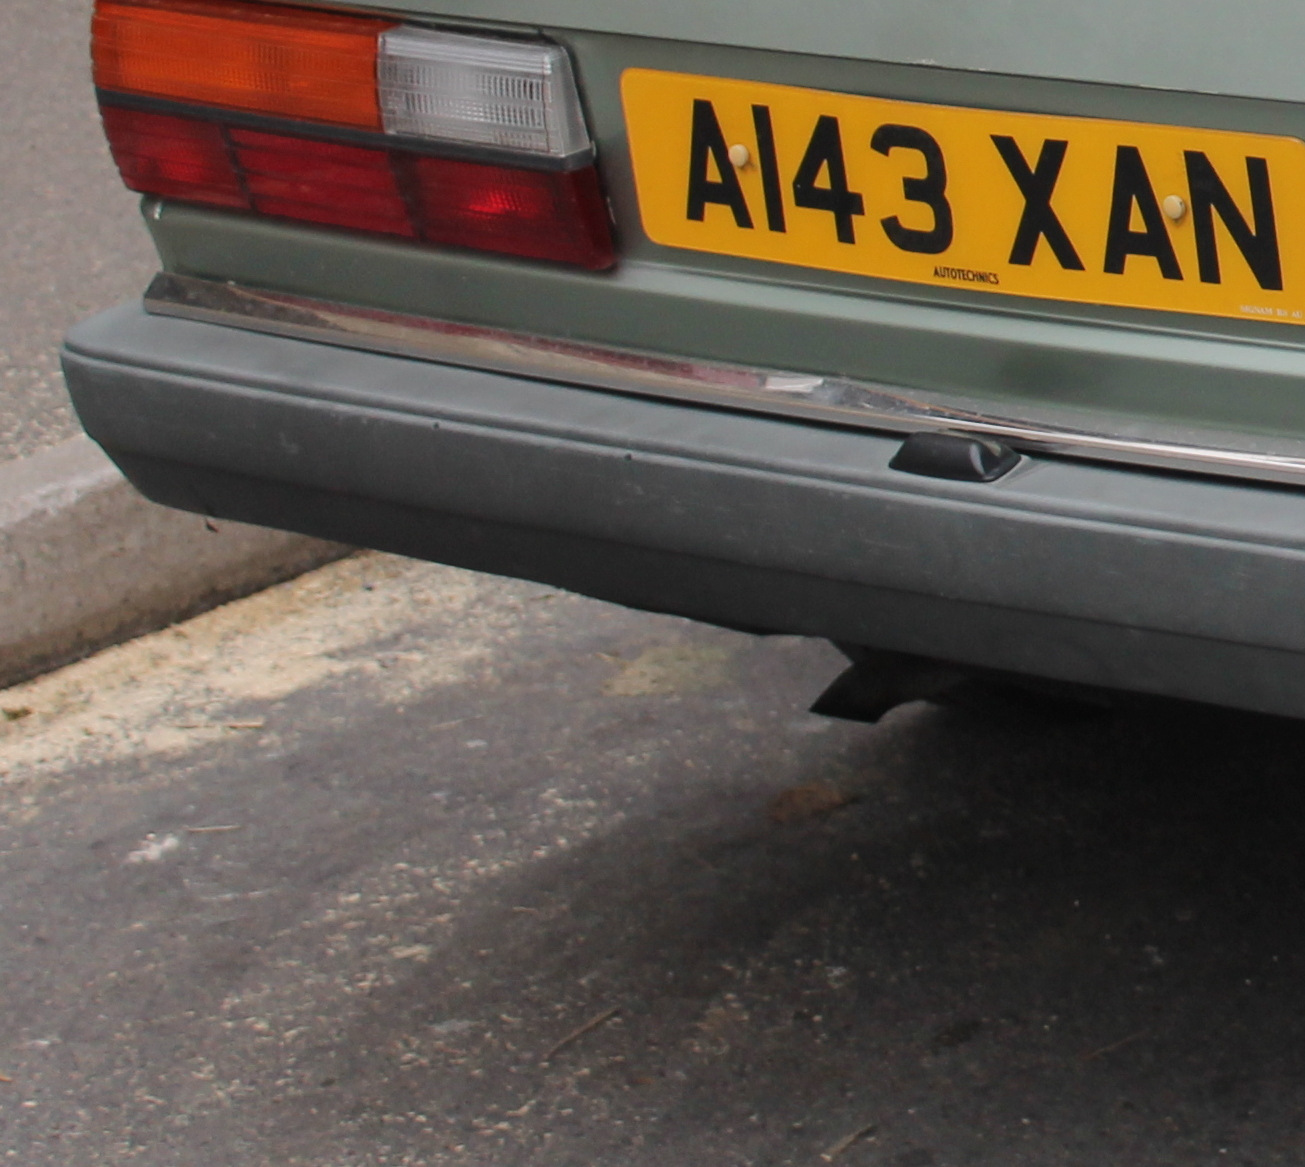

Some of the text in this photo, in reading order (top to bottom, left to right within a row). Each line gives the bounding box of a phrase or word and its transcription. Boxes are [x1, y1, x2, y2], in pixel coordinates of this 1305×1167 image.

[686, 98, 1285, 292] A143 XAN
[933, 265, 1000, 285] AUTOTECHNICS
